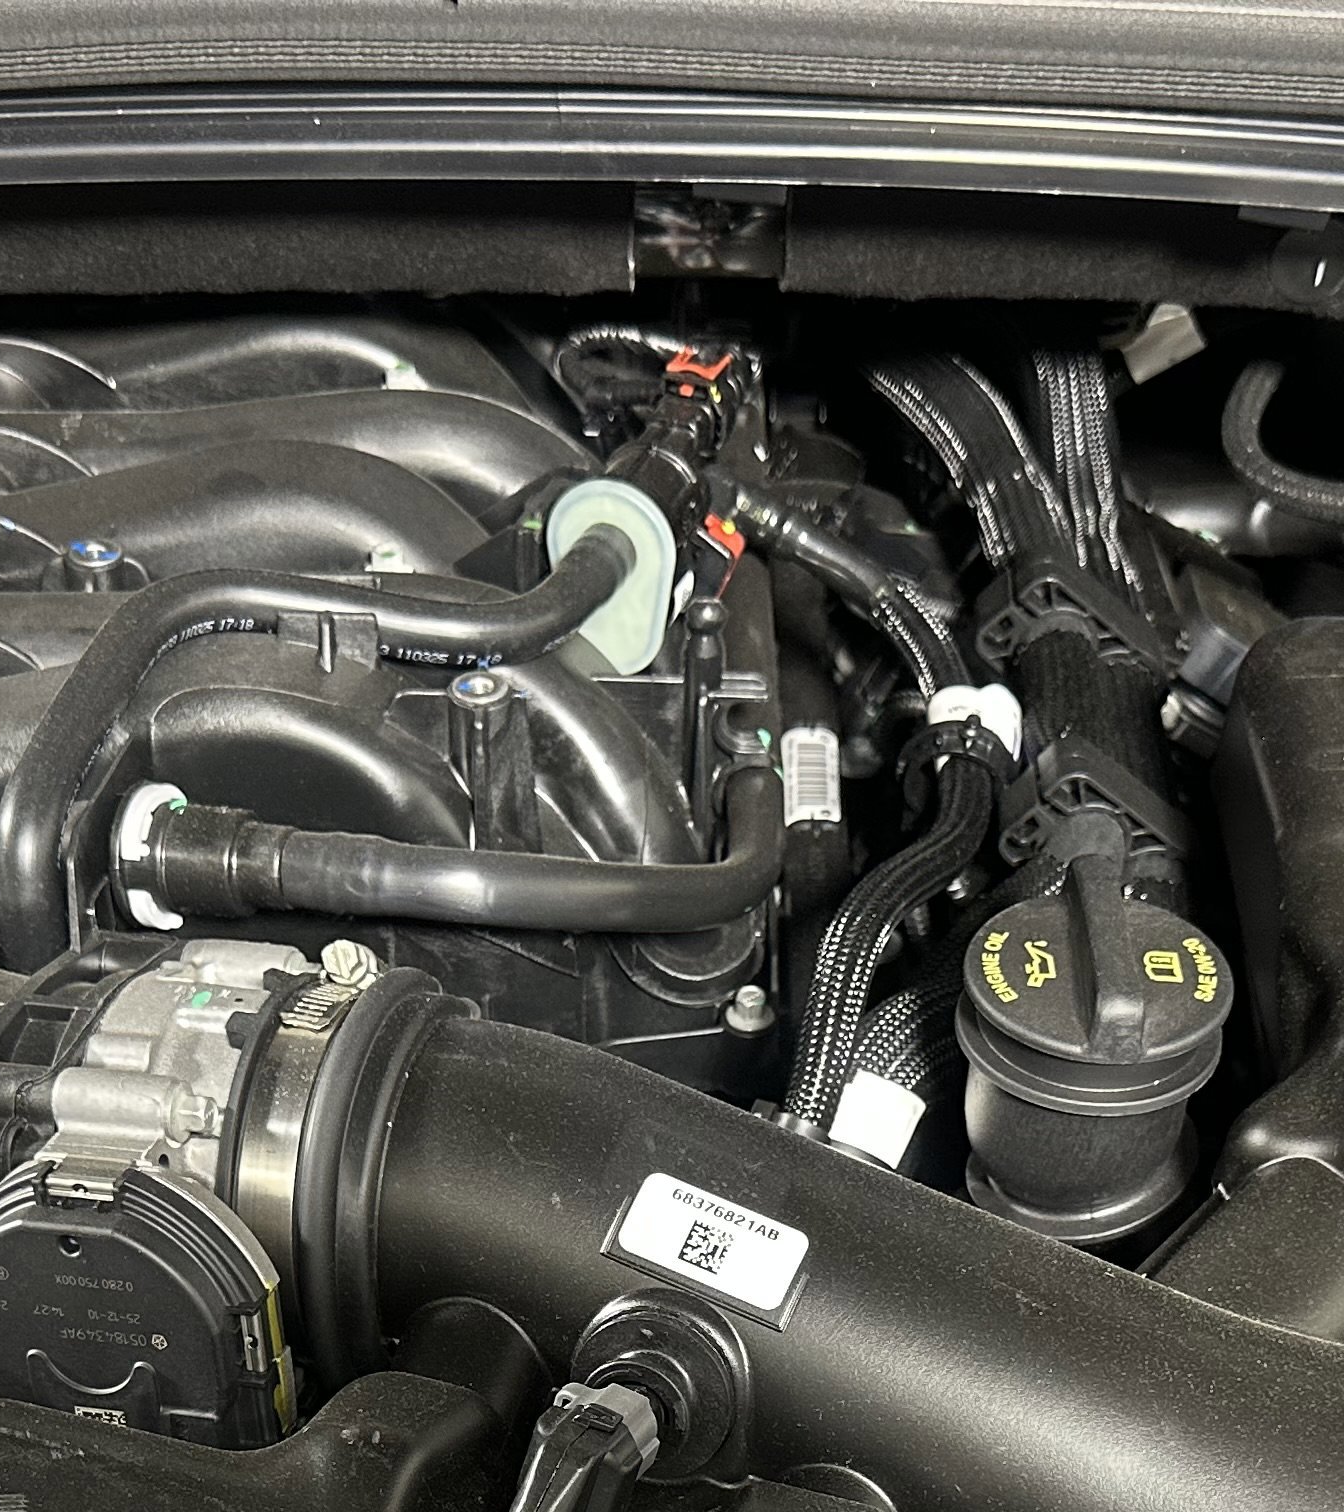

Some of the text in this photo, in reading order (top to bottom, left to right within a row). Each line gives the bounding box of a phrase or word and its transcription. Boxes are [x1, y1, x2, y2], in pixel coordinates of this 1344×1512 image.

[981, 931, 1019, 1003] ENGINE OIL
[1182, 938, 1218, 1003] SAE 0W-20
[672, 1188, 780, 1241] 68376821AB
[59, 1328, 147, 1346] 05184349AF
[88, 1309, 141, 1325] 25-12-10
